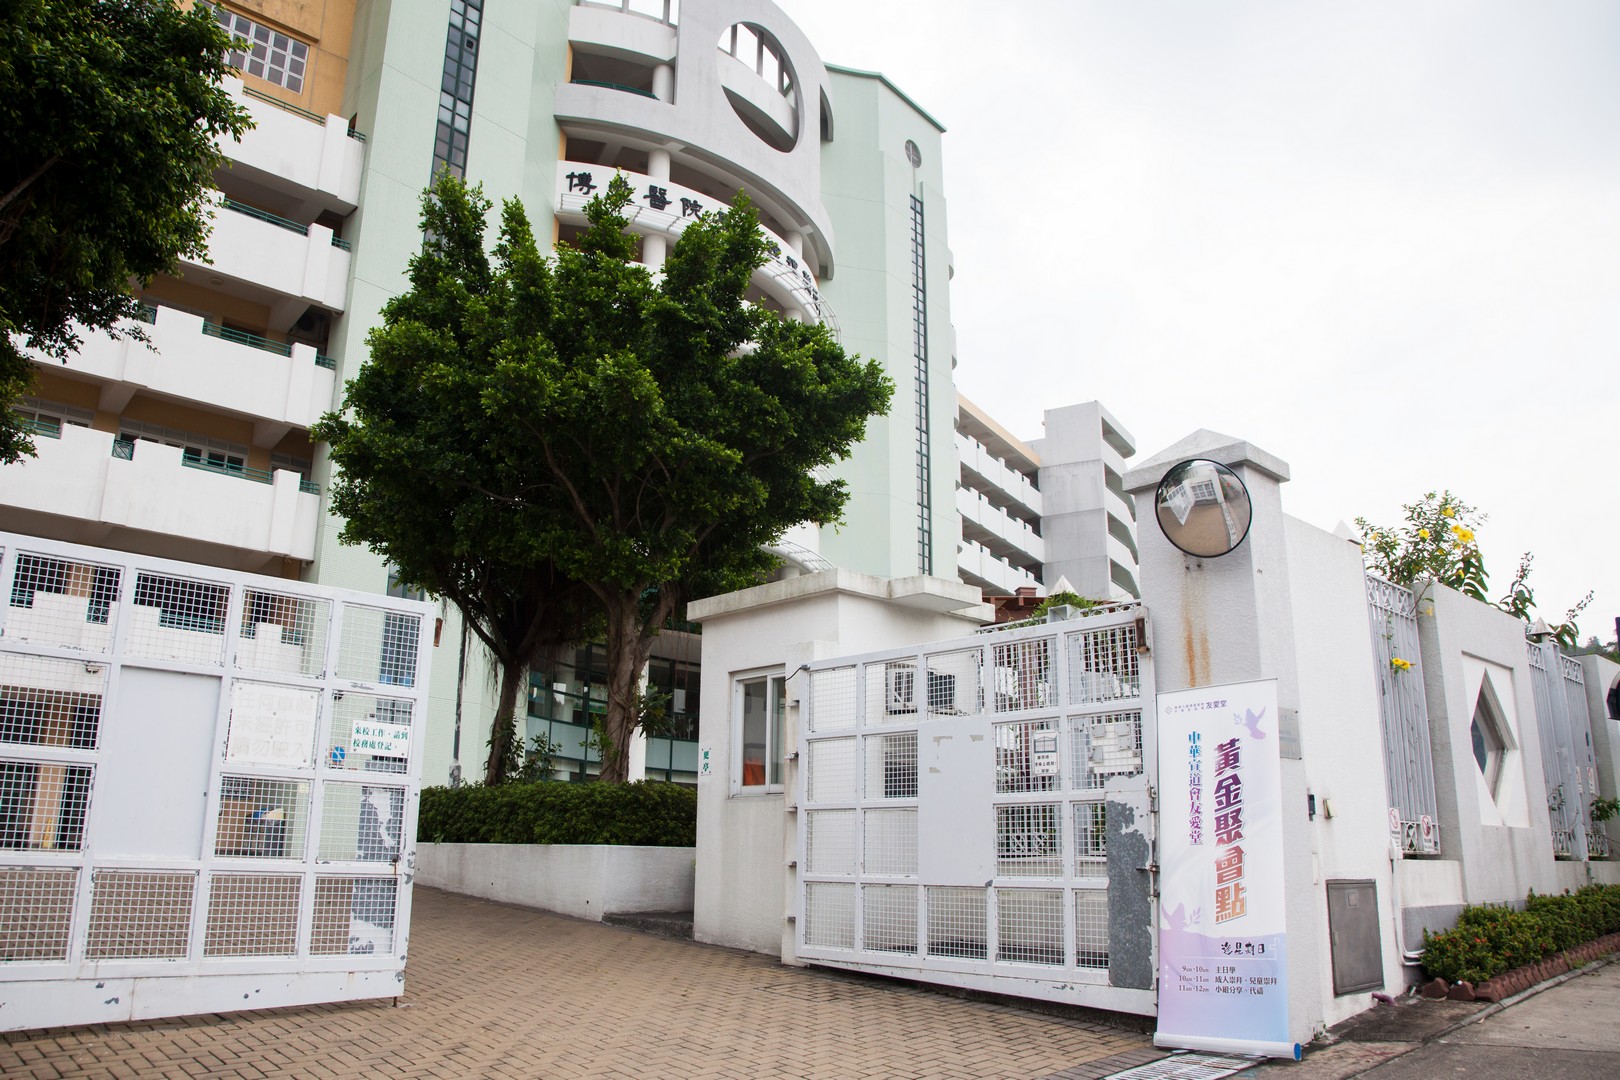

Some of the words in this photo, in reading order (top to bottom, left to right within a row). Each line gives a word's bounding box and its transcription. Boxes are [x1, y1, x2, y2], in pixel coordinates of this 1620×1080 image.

[1206, 700, 1227, 709] 友愛堂
[1188, 731, 1204, 846] 中華宣道會友愛堂
[1214, 737, 1247, 925] 黃金聚會點
[1215, 966, 1236, 974] 主日學
